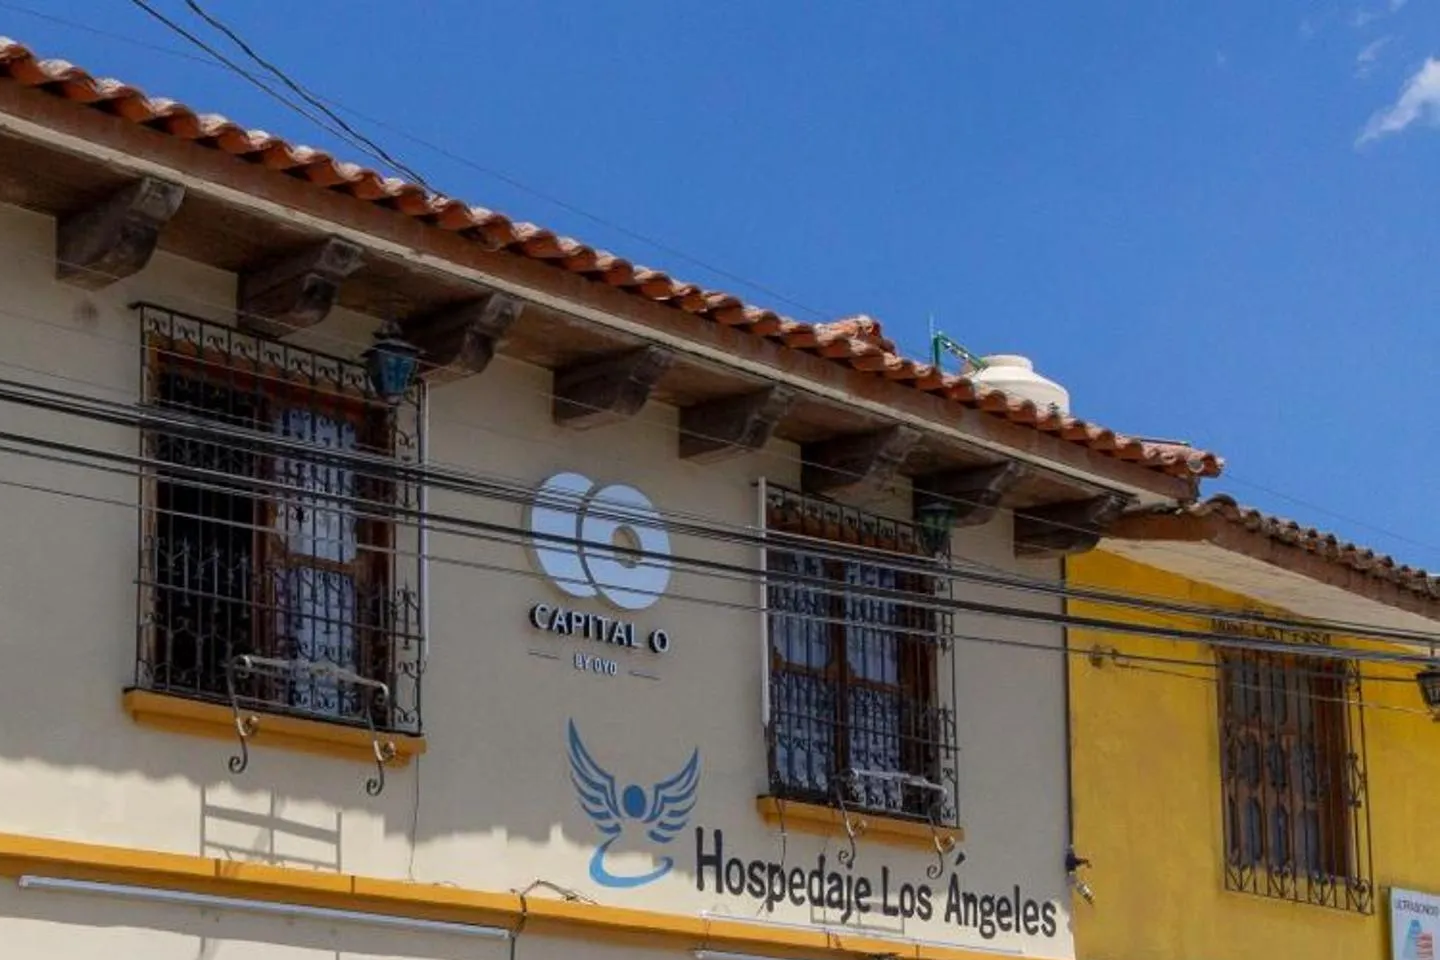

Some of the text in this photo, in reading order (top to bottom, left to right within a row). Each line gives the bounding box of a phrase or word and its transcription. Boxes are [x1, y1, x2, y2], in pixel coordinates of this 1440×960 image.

[530, 603, 670, 653] CAPITAL O
[694, 826, 1058, 940] Hospedaje Los Ángeles
